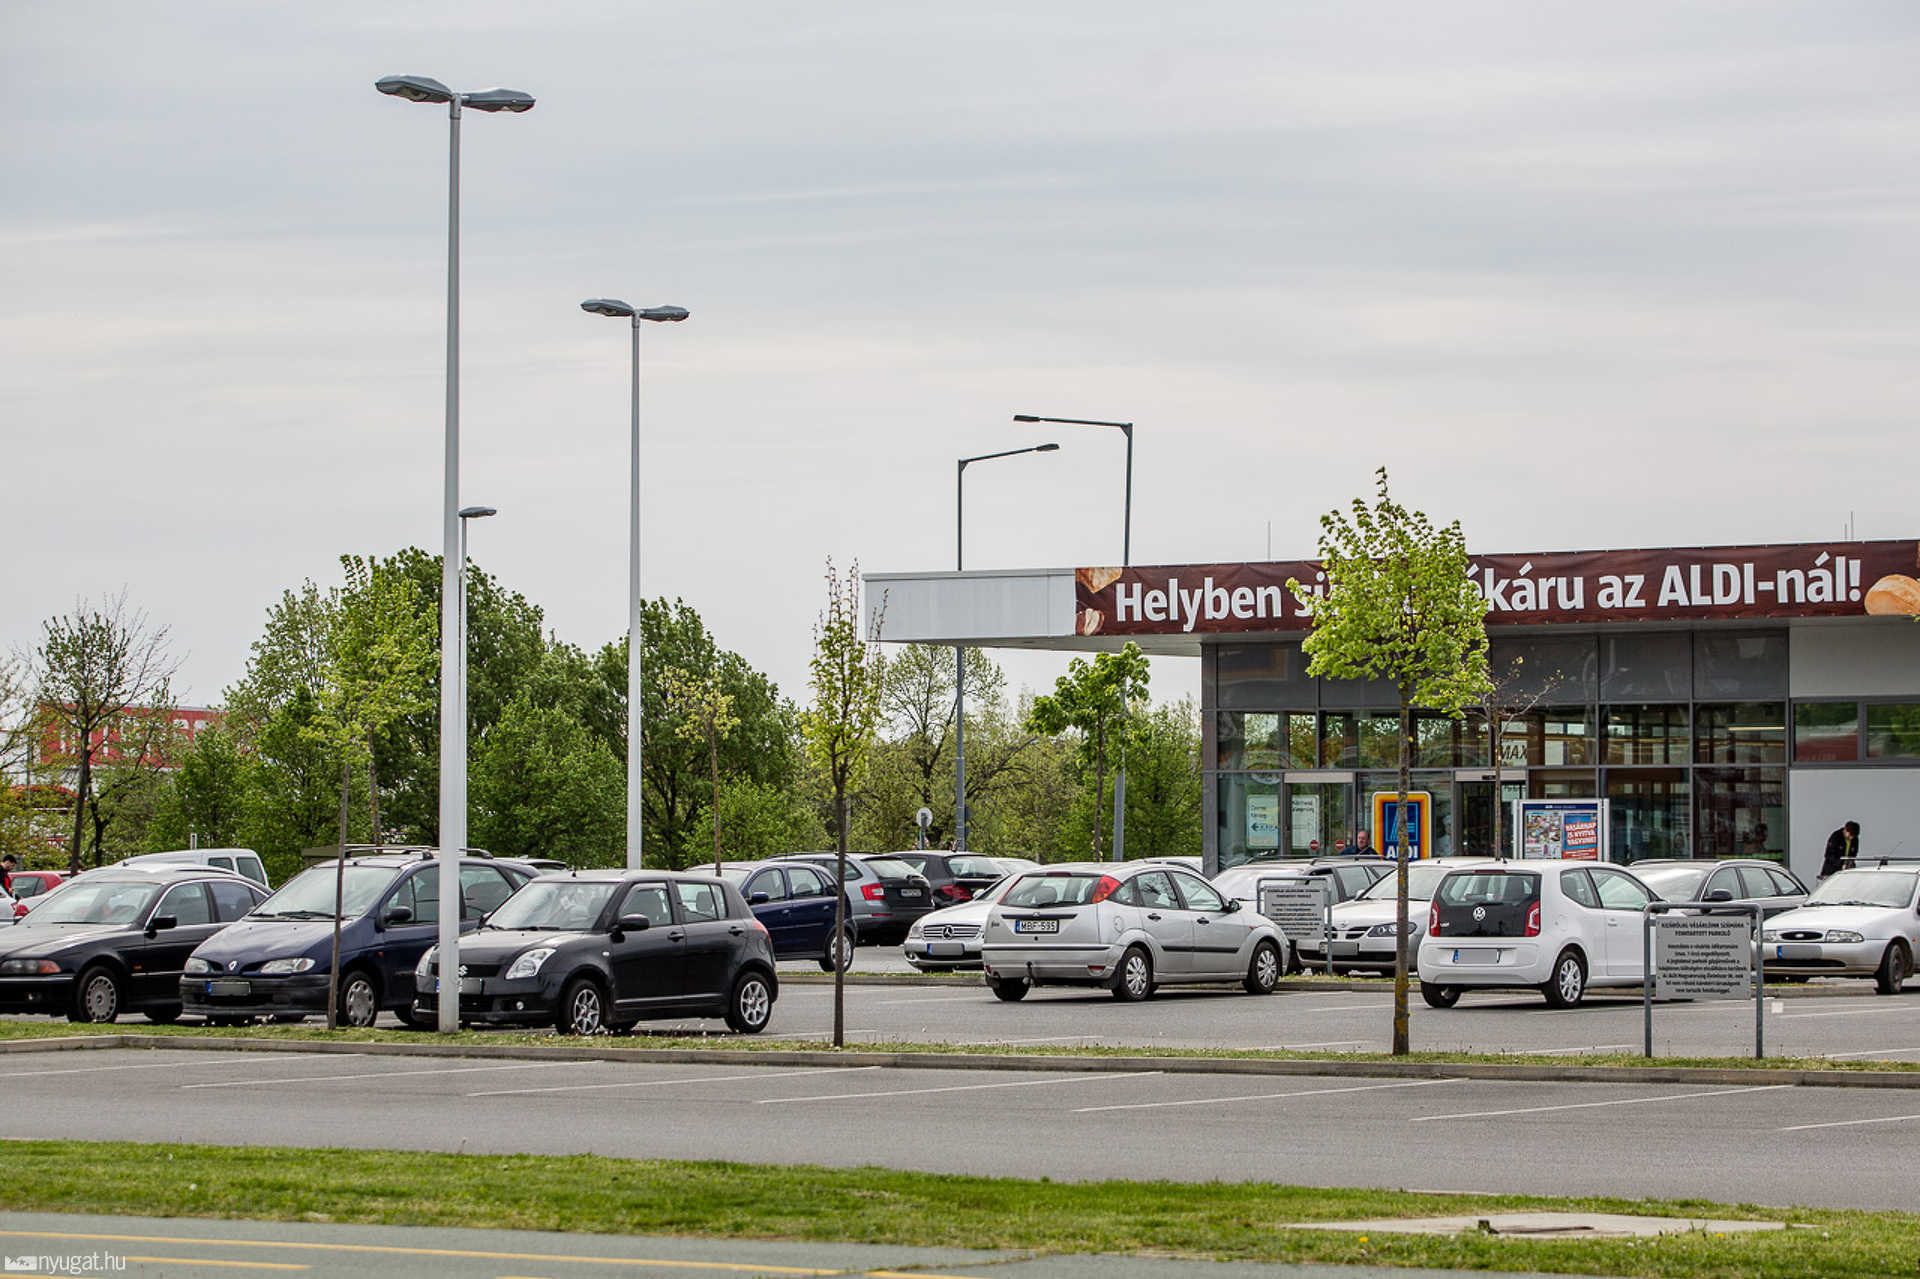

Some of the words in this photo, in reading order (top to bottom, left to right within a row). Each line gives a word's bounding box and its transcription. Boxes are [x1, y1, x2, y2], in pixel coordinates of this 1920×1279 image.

[1116, 577, 1282, 632] Helyben
[1434, 561, 1535, 618] ékáru
[1597, 574, 1647, 609] az
[1657, 551, 1861, 607] ALDI-nál!
